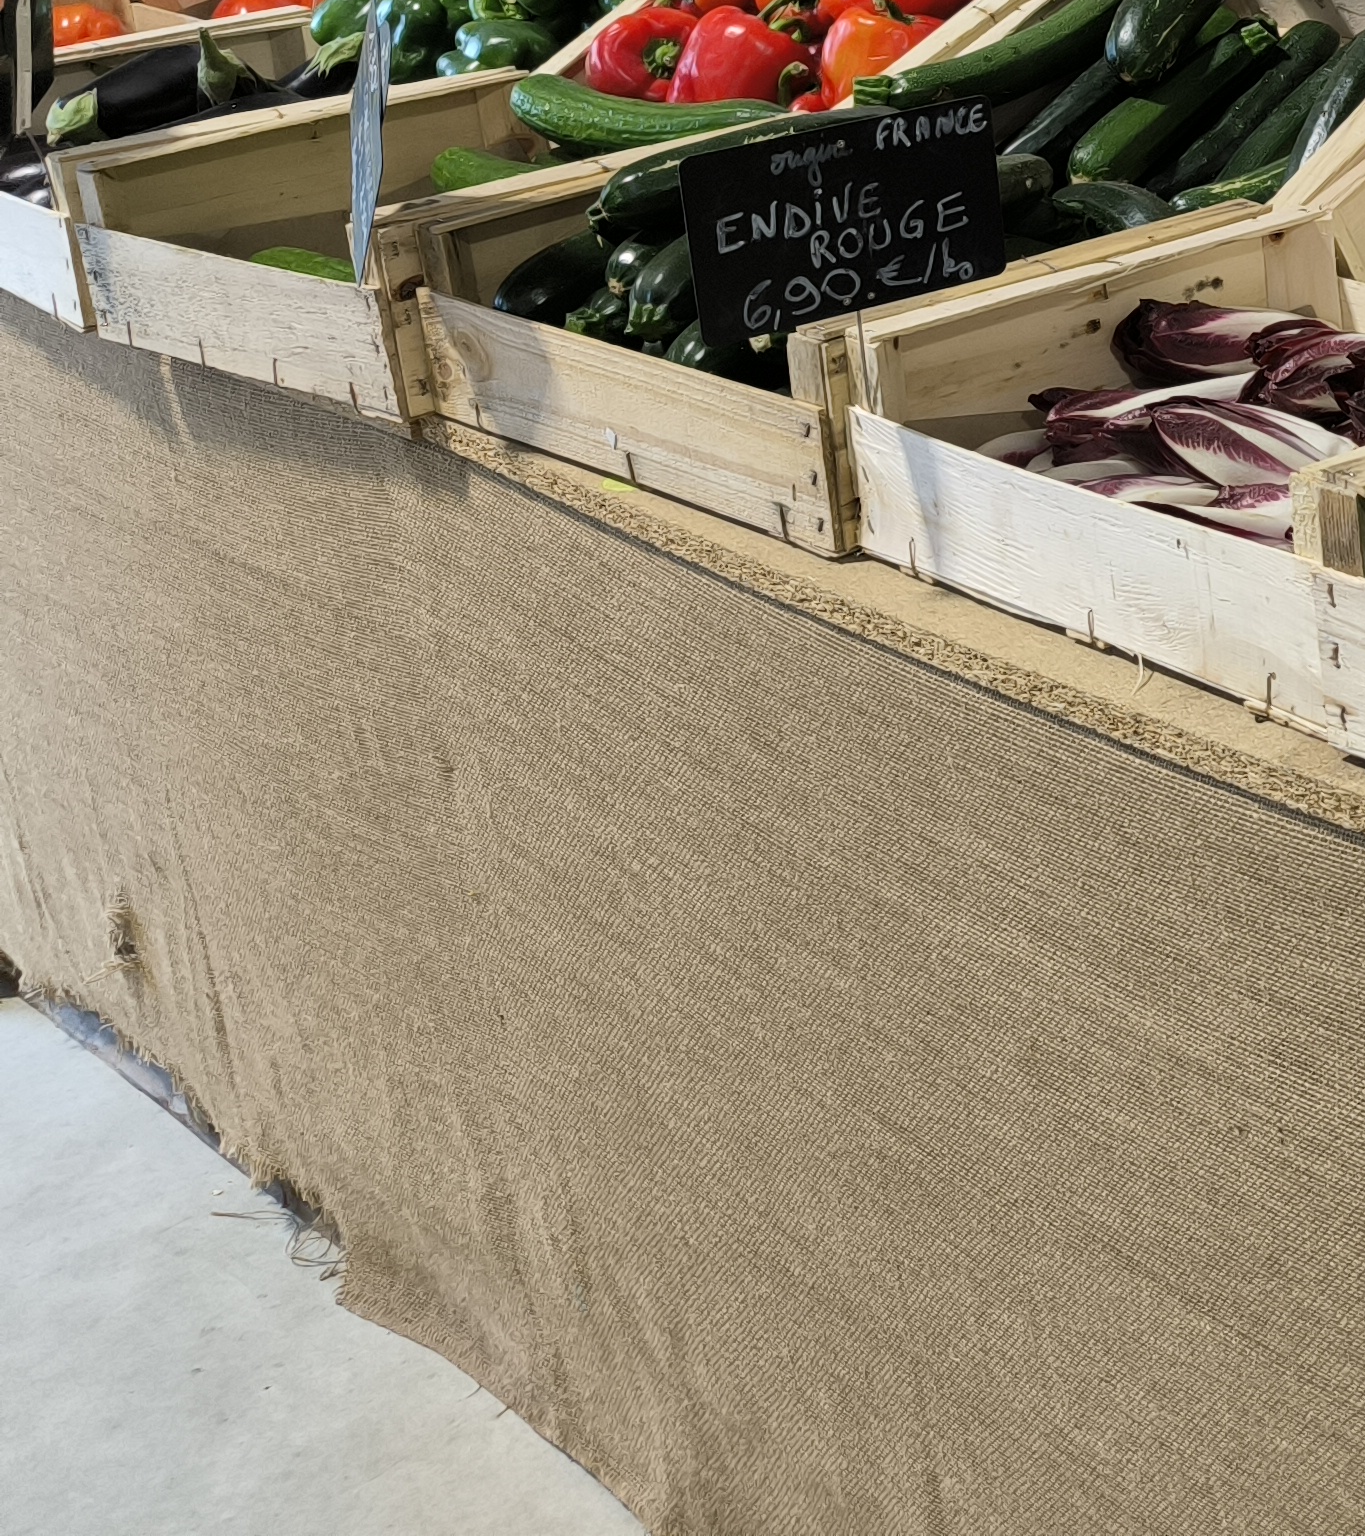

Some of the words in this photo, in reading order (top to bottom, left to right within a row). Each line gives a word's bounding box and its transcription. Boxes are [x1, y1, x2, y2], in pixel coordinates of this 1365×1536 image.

[874, 104, 988, 151] FRANCE
[810, 191, 969, 269] ROUGE
[743, 268, 861, 331] 6,90
